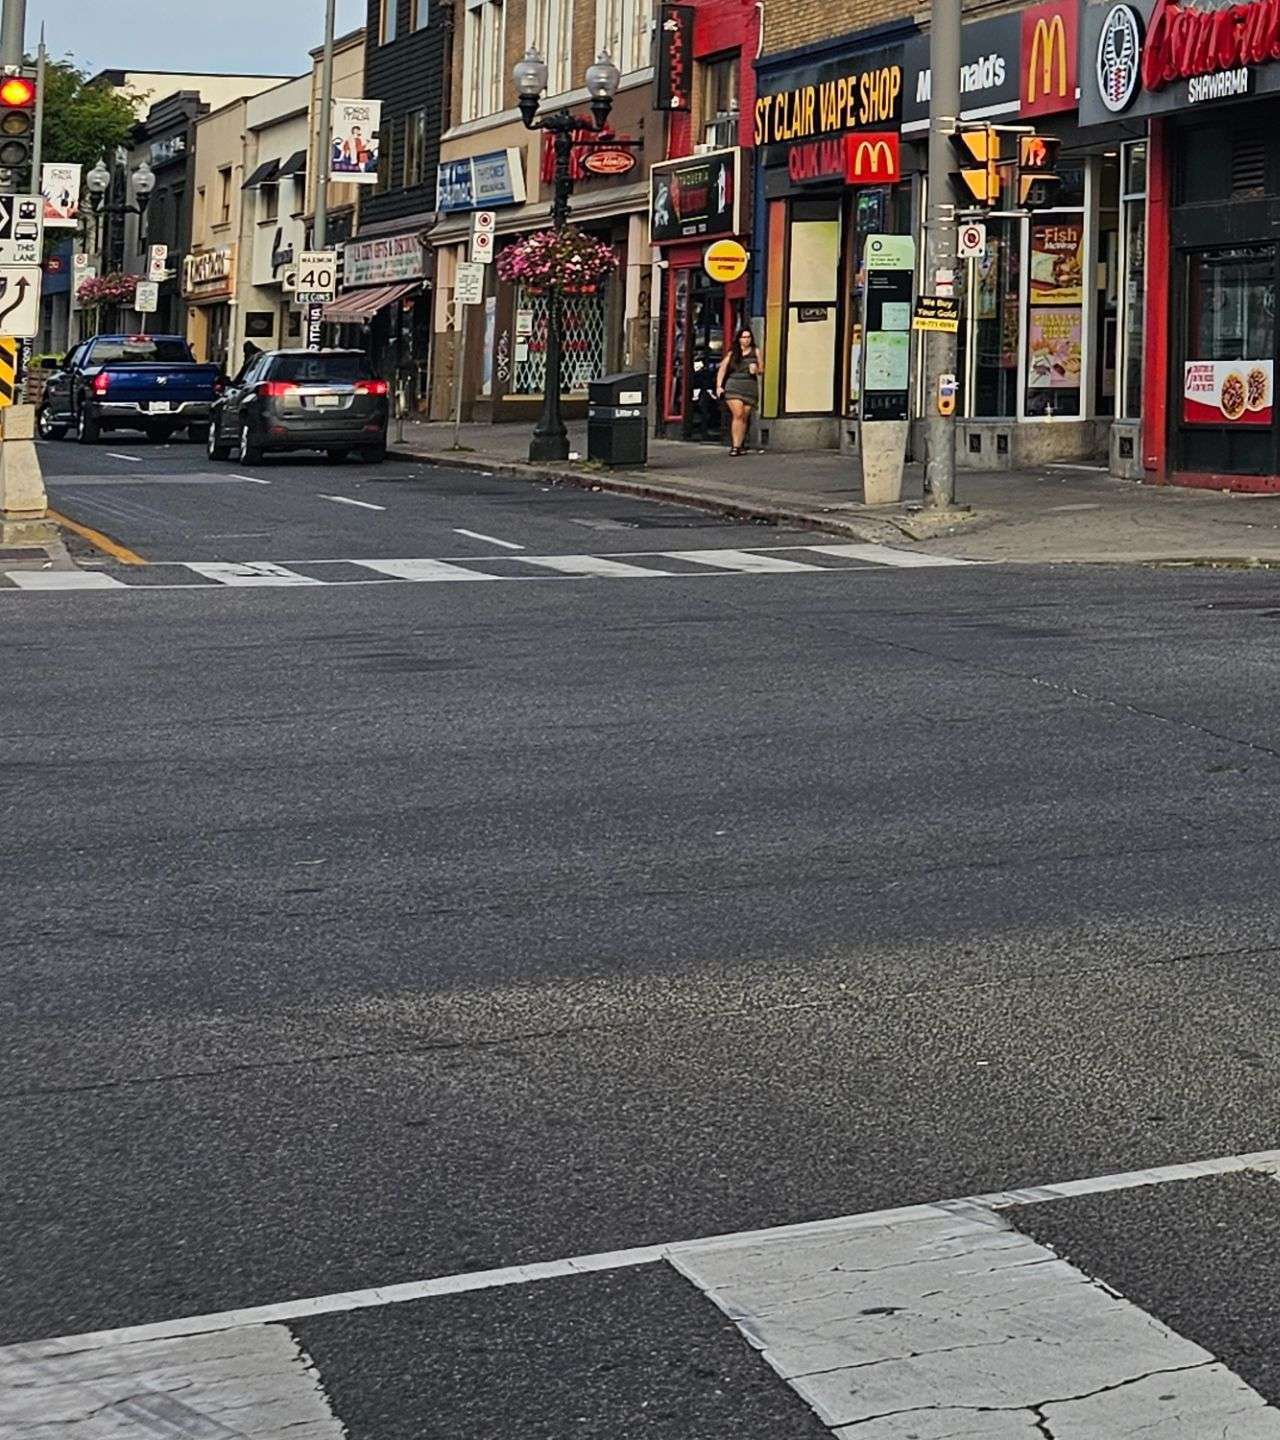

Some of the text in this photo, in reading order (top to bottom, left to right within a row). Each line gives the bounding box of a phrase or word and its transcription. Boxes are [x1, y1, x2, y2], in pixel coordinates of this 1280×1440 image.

[916, 53, 1006, 105] Mnald's
[1188, 67, 1249, 103] SHAWARMA
[754, 65, 901, 146] ST CLAIR VAPE SHOP
[789, 143, 818, 181] QUIK
[1045, 227, 1077, 242] Fish
[16, 244, 35, 252] THIS
[13, 253, 37, 262] LANE
[301, 270, 331, 288] 40
[299, 292, 331, 302] BEGINS
[922, 298, 953, 309] We Buy
[917, 308, 957, 318] Your Gold
